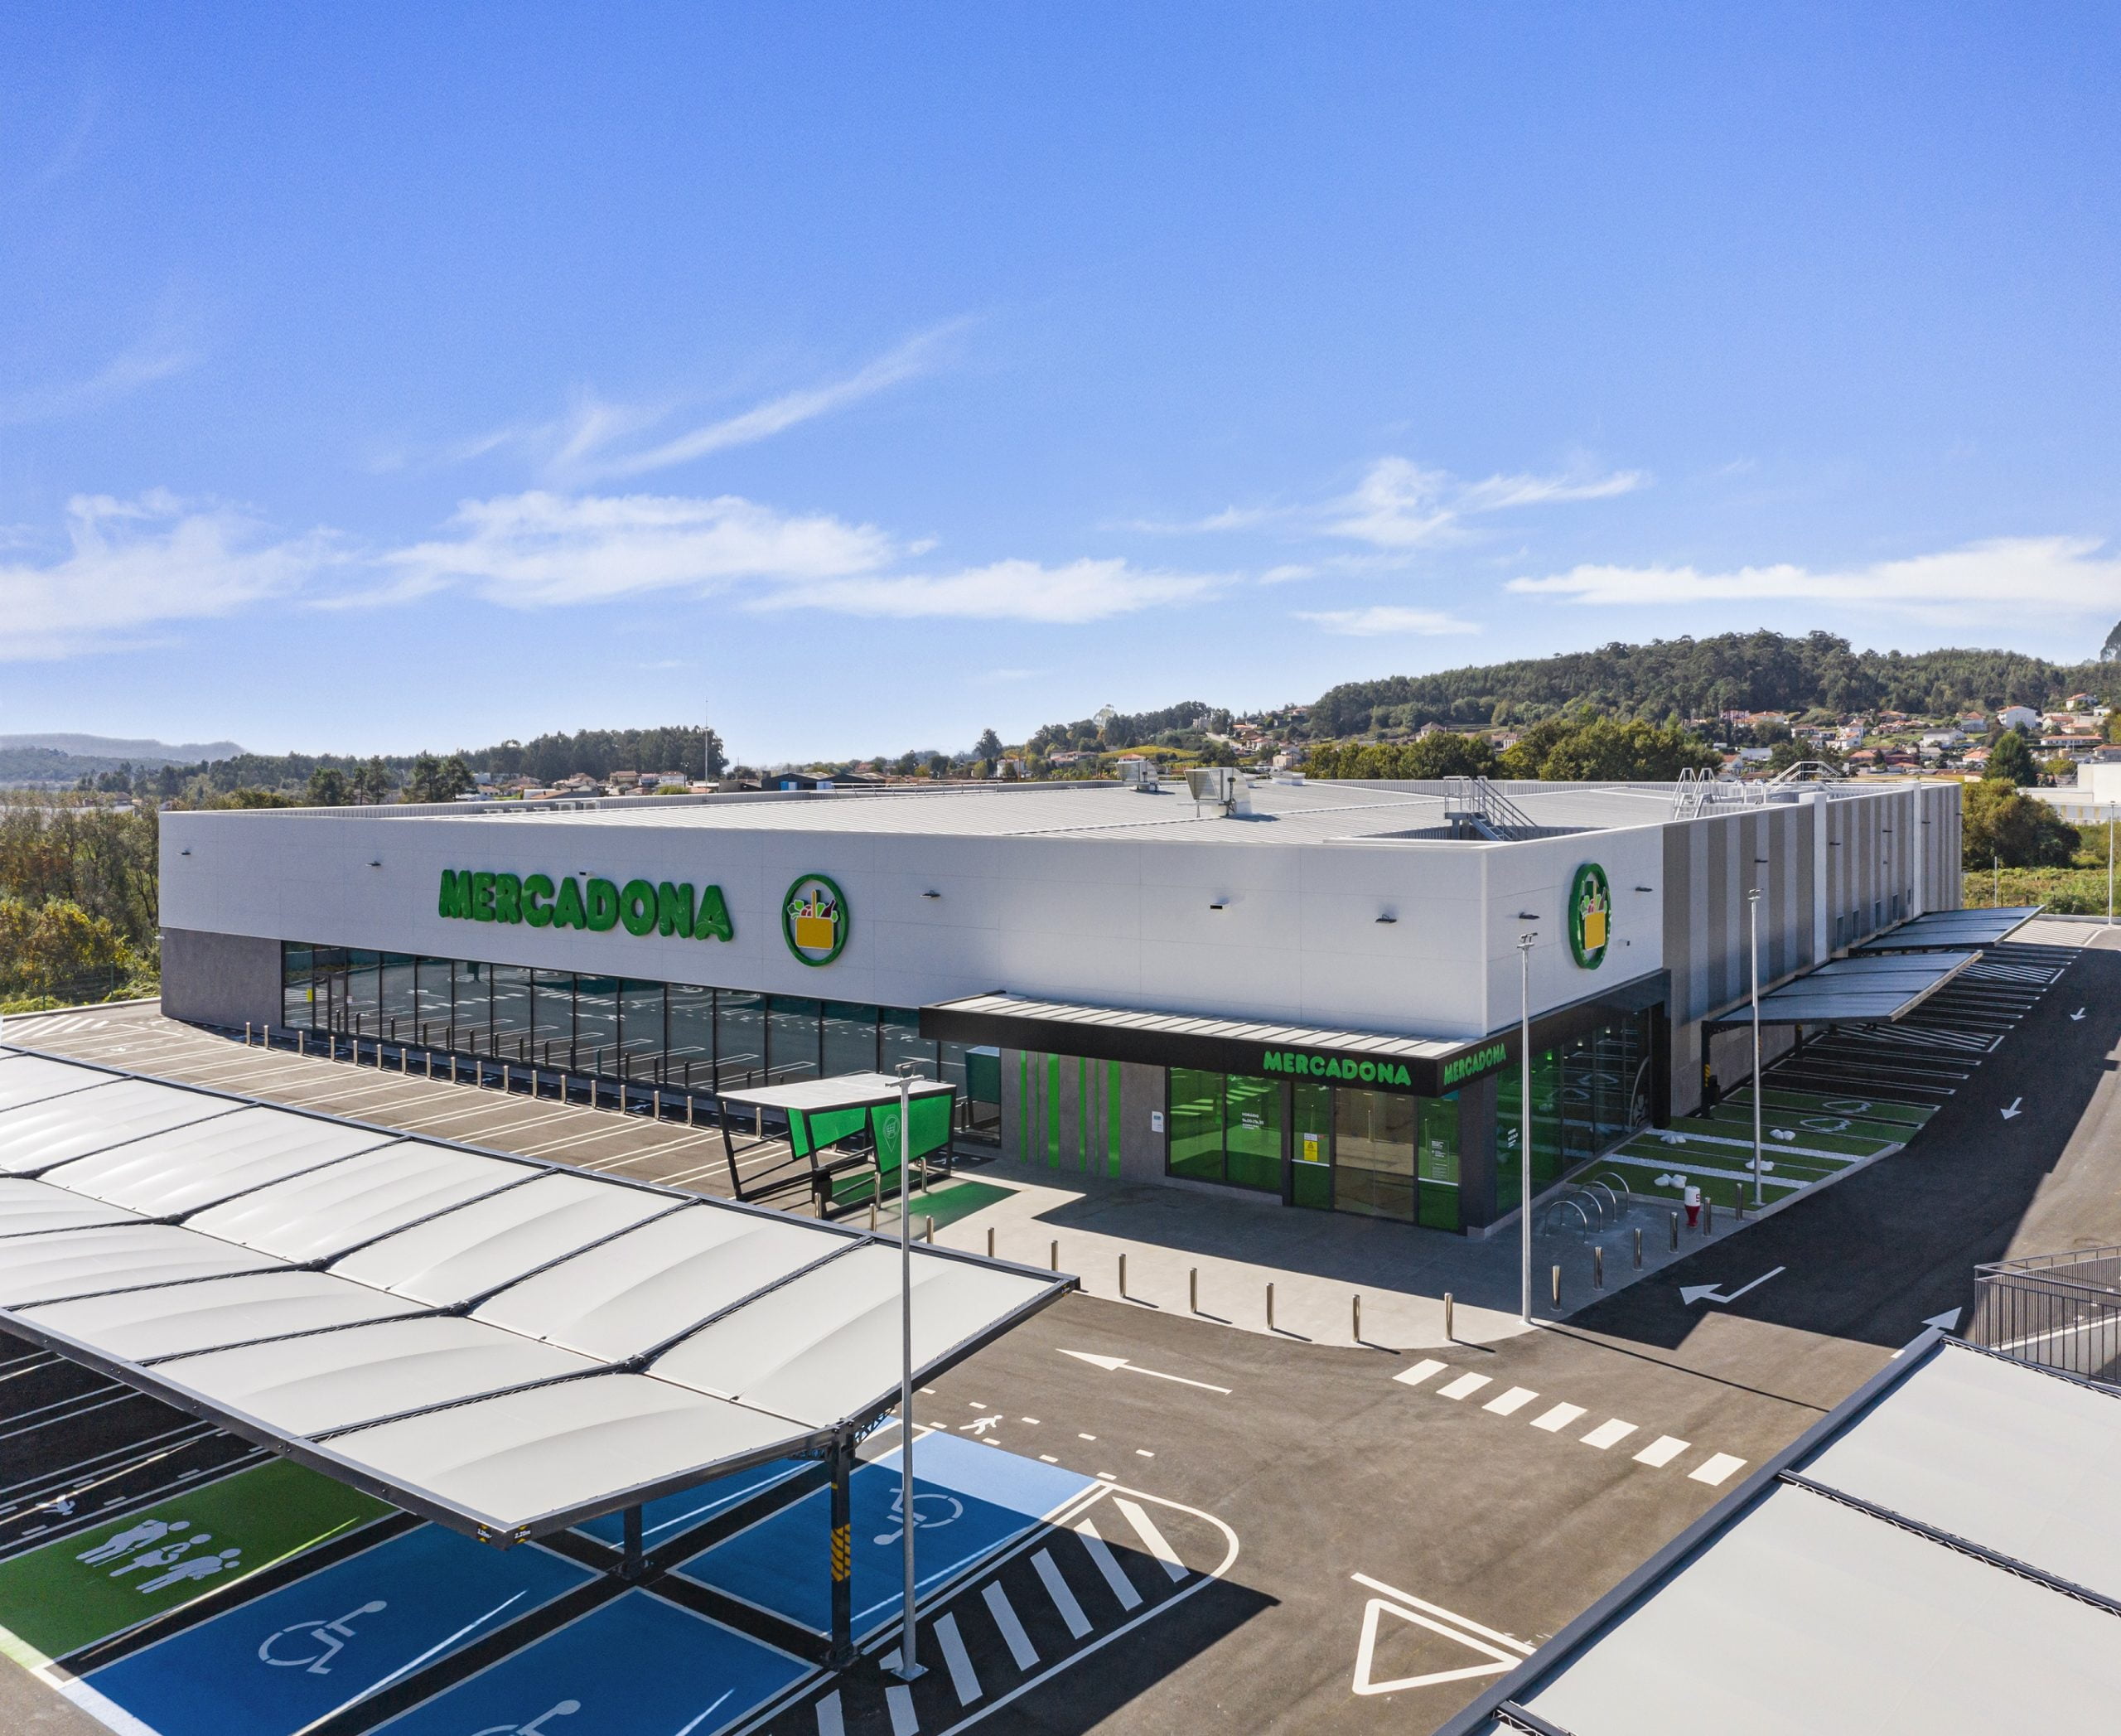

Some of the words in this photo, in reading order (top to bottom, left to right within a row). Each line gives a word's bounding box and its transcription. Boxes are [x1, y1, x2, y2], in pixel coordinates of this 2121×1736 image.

[438, 869, 734, 942] MERCADONA
[1263, 1050, 1412, 1086] MERCADONA
[1443, 1042, 1507, 1086] MERCADONA
